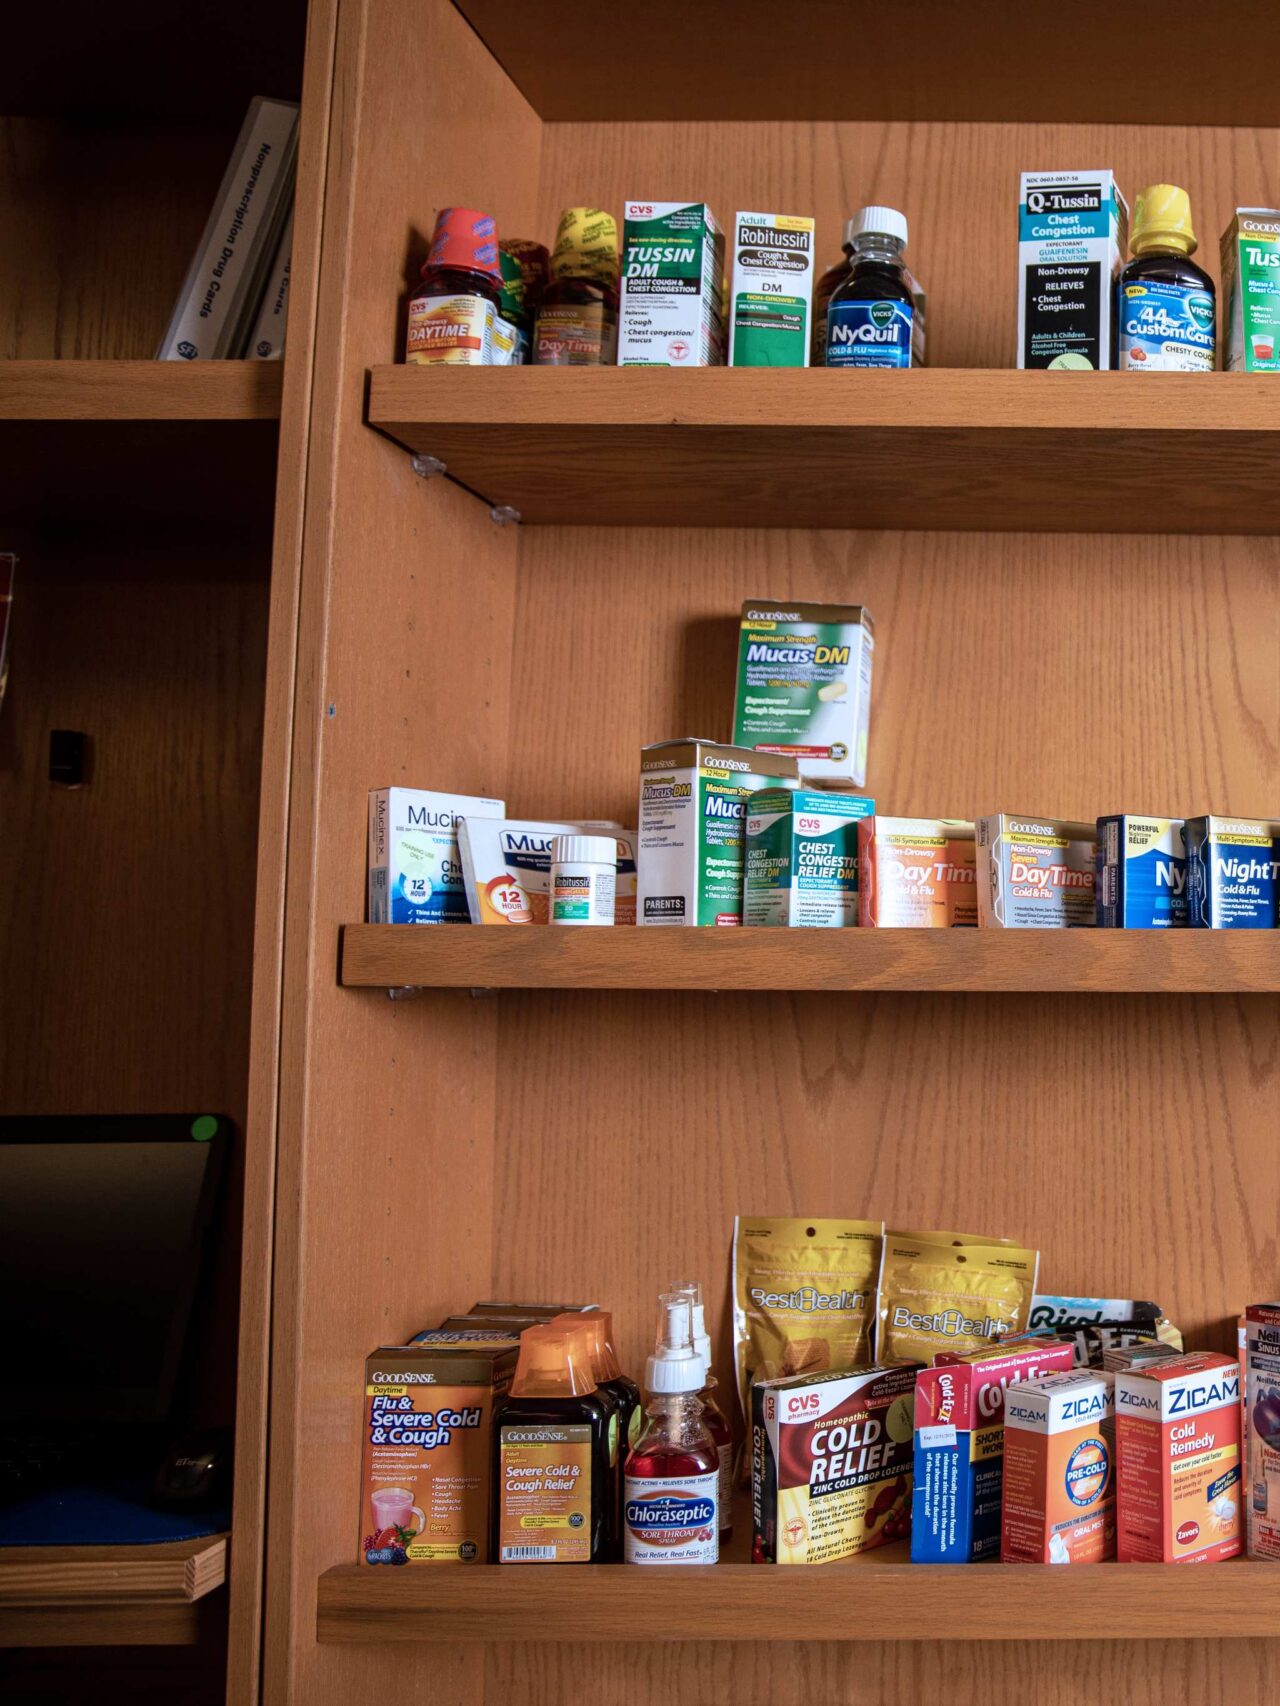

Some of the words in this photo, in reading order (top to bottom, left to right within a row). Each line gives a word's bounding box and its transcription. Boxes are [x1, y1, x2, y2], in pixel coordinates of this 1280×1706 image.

[226, 143, 271, 245] Nonprescription
[1028, 193, 1099, 213] Q-Tussin
[630, 205, 653, 214] CVS
[739, 217, 766, 225] Adult
[1048, 215, 1079, 224] Chest
[1032, 226, 1095, 237] Congestion
[741, 229, 808, 248] Robitussin
[628, 247, 695, 262] TUSSIN
[212, 246, 234, 278] Drug
[627, 263, 657, 277] DM
[1038, 267, 1089, 276] Non-Drowsy
[762, 282, 782, 292] DM
[1045, 282, 1084, 291] RELIEVES
[200, 280, 221, 318] Cards
[1038, 295, 1061, 303] Chest
[1038, 303, 1085, 312] Congestion
[410, 324, 469, 340] DAYTIME
[832, 325, 898, 343] NyQuil
[1127, 320, 1184, 339] Custom
[748, 634, 785, 642] Maximum
[786, 635, 817, 643] Strength
[713, 770, 727, 778] Hour
[799, 819, 820, 829] CVS
[1129, 823, 1159, 834] POWERFUL
[1129, 837, 1148, 845] RELIEF
[799, 842, 835, 854] CHEST
[1011, 854, 1037, 864] Severe
[798, 867, 834, 878] RELIEF
[837, 868, 854, 878] DM
[412, 880, 425, 889] 12
[499, 891, 521, 903] 12
[1168, 1378, 1240, 1414] ZICAM
[373, 1397, 397, 1410] Flu
[788, 1394, 820, 1413] CVS
[372, 1411, 431, 1427] Severe
[437, 1410, 479, 1426] Cold
[788, 1410, 820, 1420] pharmacy
[810, 1420, 881, 1455] COLD
[1170, 1422, 1196, 1441] Cold
[390, 1429, 449, 1448] Cough
[1170, 1432, 1216, 1456] Remedy
[810, 1442, 897, 1485] RELIEF
[506, 1466, 543, 1477] Severe
[545, 1465, 570, 1477] Cold
[506, 1480, 542, 1492] Cough
[544, 1479, 575, 1491] Relief
[812, 1484, 834, 1495] ZINC
[835, 1479, 857, 1490] COLD
[858, 1474, 880, 1485] DROP
[626, 1504, 710, 1522] Chloraseptic
[430, 1524, 449, 1532] Berry
[641, 1530, 666, 1539] SORE
[668, 1529, 696, 1538] THROAT
[1177, 1526, 1199, 1539] Zavors
